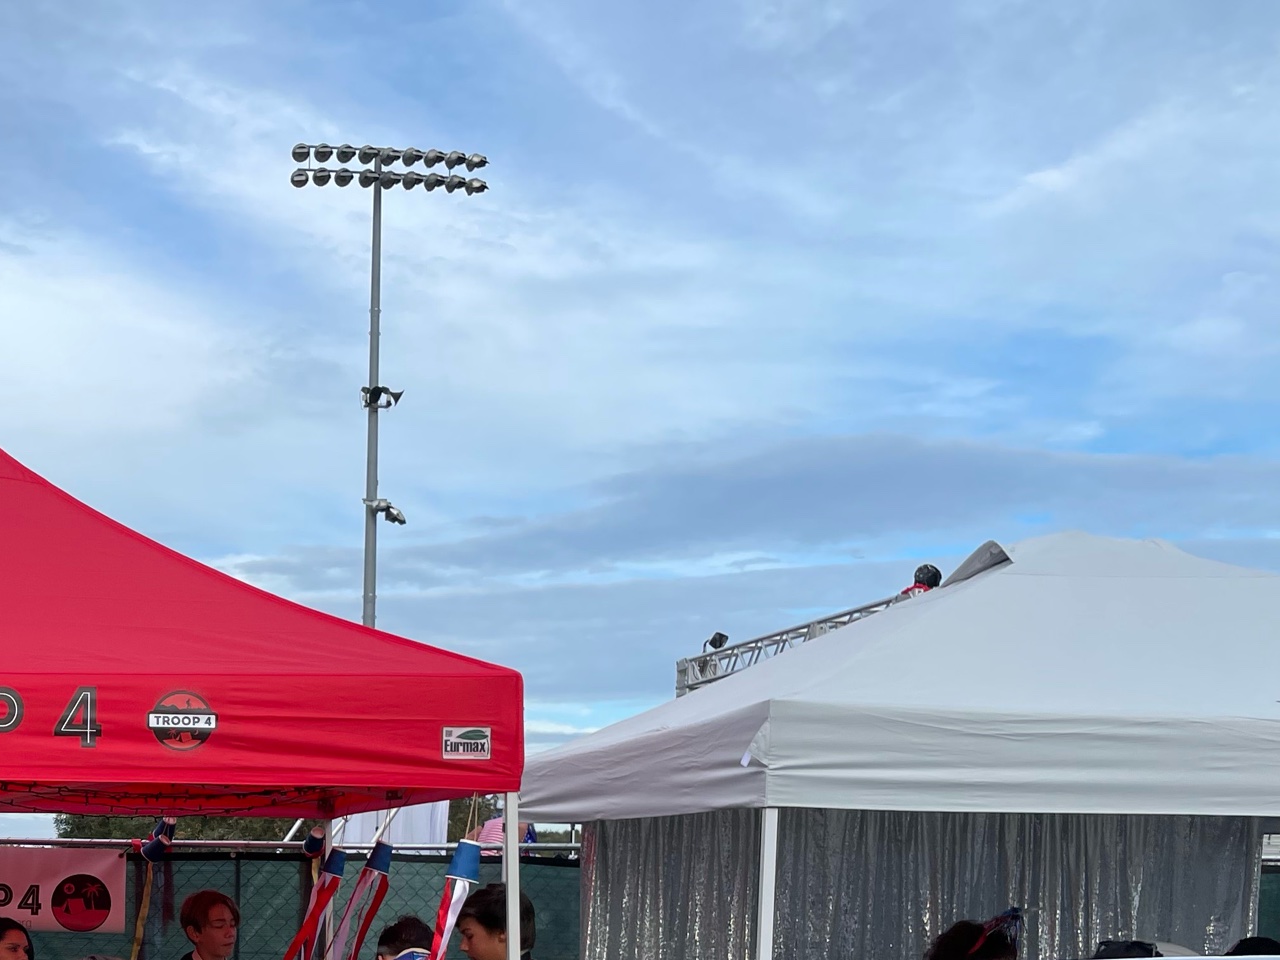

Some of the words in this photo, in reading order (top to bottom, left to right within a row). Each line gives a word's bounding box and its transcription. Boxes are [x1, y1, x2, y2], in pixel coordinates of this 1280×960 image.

[54, 686, 102, 749] 4
[154, 715, 202, 727] TROOP
[204, 716, 213, 727] 4
[444, 739, 486, 753] Eurmax
[17, 884, 42, 915] 4
